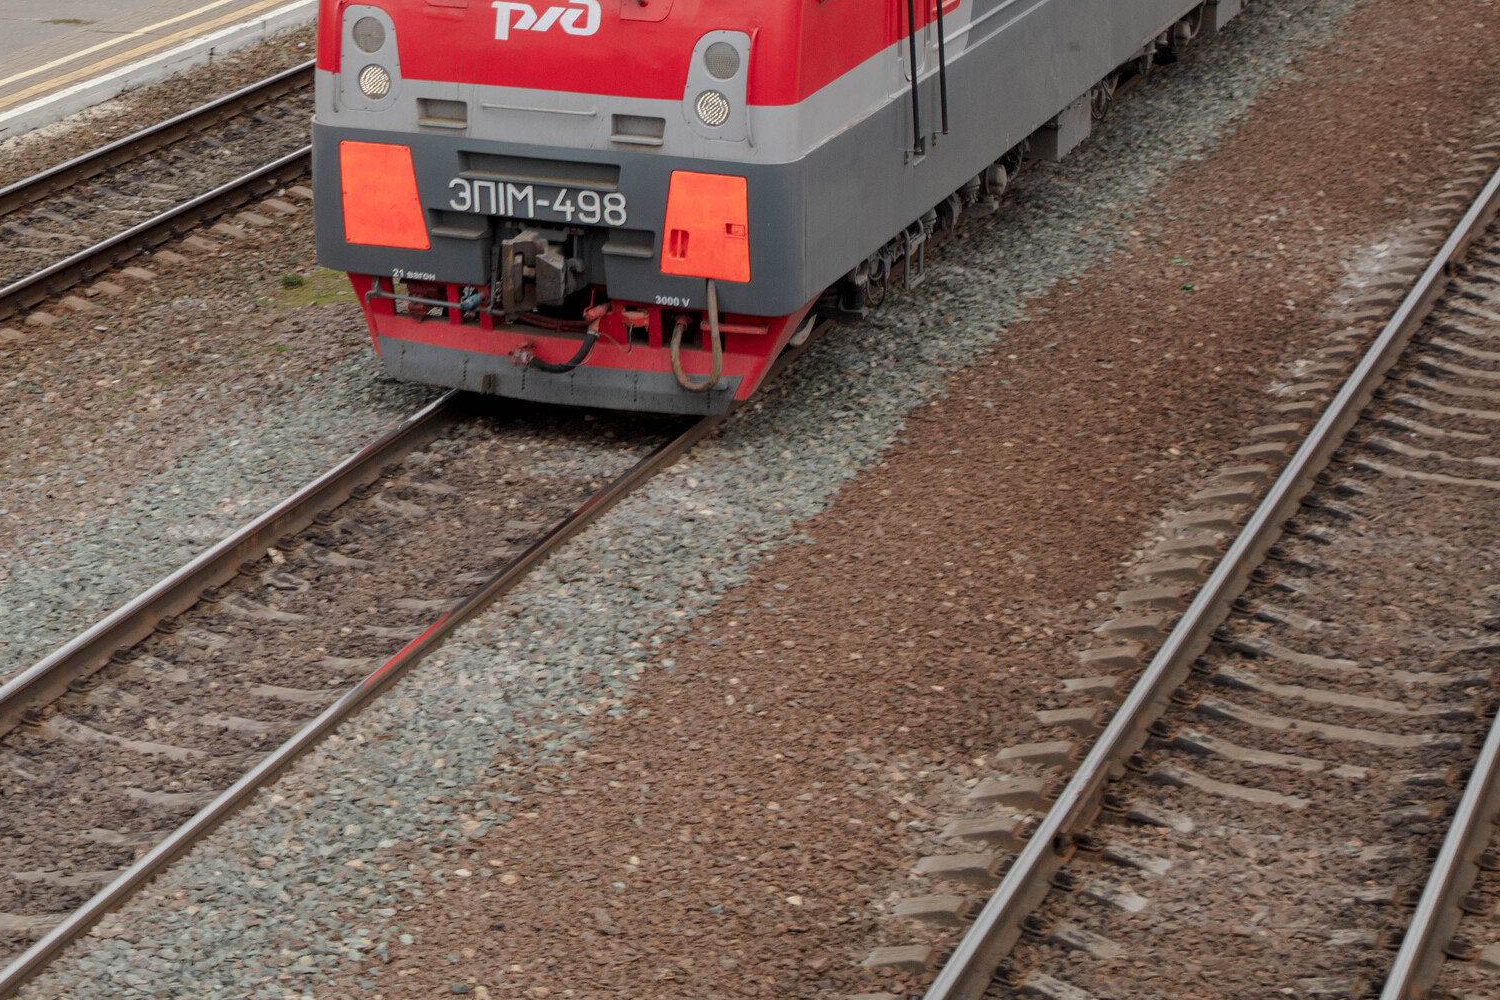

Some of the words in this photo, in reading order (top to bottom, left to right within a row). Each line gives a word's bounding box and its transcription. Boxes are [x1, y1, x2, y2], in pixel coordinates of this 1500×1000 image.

[392, 267, 404, 278] 21
[406, 270, 436, 281] вагон
[655, 294, 680, 306] 3000
[681, 297, 690, 307] V
